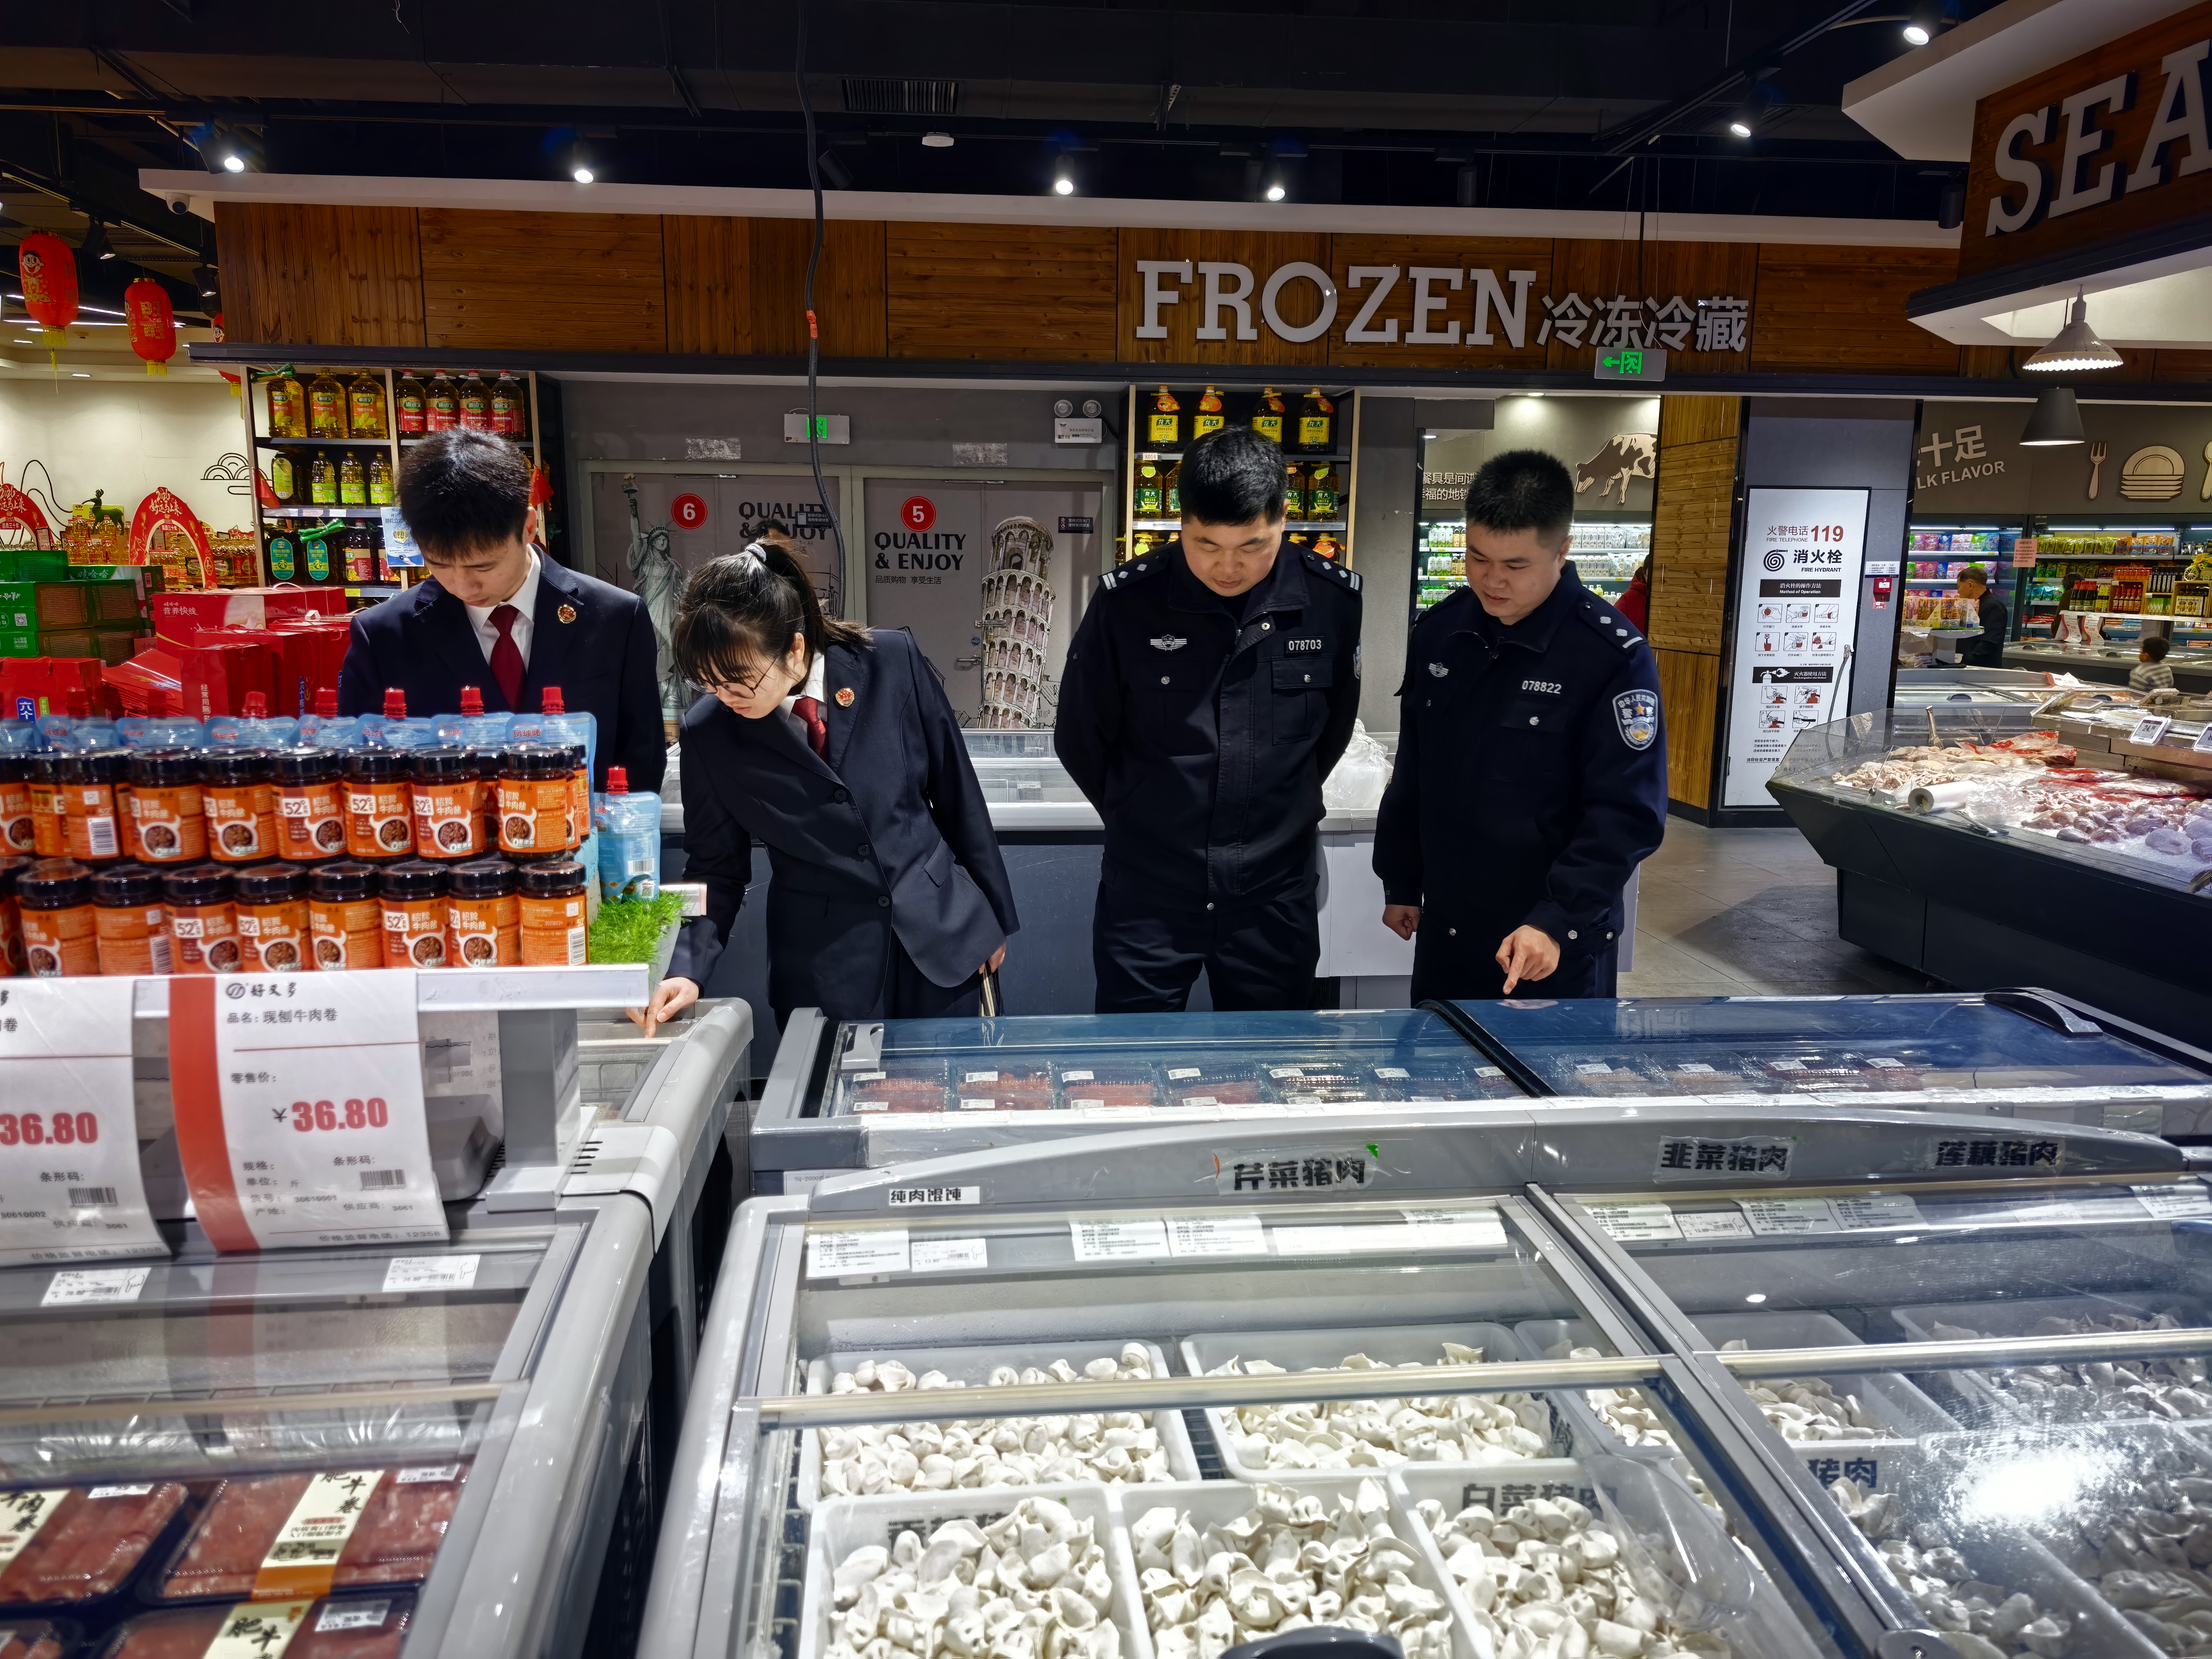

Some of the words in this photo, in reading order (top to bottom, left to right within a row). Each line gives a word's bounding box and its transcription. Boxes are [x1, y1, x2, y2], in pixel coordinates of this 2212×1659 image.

[1136, 260, 1536, 348] FROZEN
[1537, 292, 1748, 351] 冷冻冷藏
[1917, 425, 1987, 468] 十足
[1941, 461, 2005, 485] FLAVOR
[682, 502, 696, 520] 6
[913, 506, 924, 523] 5
[874, 532, 966, 550] QUALITY
[1767, 525, 1809, 536] 火警电话
[1811, 525, 1844, 542] 119
[875, 553, 890, 569] &
[898, 553, 964, 570] ENJOY
[1793, 549, 1843, 564] 消火栓
[876, 576, 906, 584] 品质购物
[911, 576, 942, 584] 享受生活
[163, 607, 197, 616] 营养快线
[1288, 639, 1321, 651] 078703
[1522, 680, 1562, 694] 078822
[20, 702, 33, 719] 六个
[436, 797, 454, 806] 招牌
[506, 791, 520, 801] 招牌
[285, 800, 305, 815] 52°
[353, 797, 372, 812] 52°
[415, 799, 430, 813] 52°
[387, 915, 405, 929] 52°
[462, 912, 478, 921] 招牌
[177, 922, 198, 935] 52°
[251, 982, 297, 998] 好又多
[263, 1008, 338, 1024] 现刨牛肉卷
[231, 1071, 276, 1084] 零售价:
[291, 1097, 388, 1132] 36.80
[0, 1112, 98, 1146] 36.80
[334, 1155, 375, 1166] 条形码:
[1661, 1141, 1791, 1171] 韭菜猪肉
[1936, 1141, 2058, 1169] 莲藕猪肉
[40, 1172, 84, 1182] 条形码:
[1233, 1157, 1366, 1190] 芹菜猪肉
[890, 1187, 962, 1204] 纯肉馄饨
